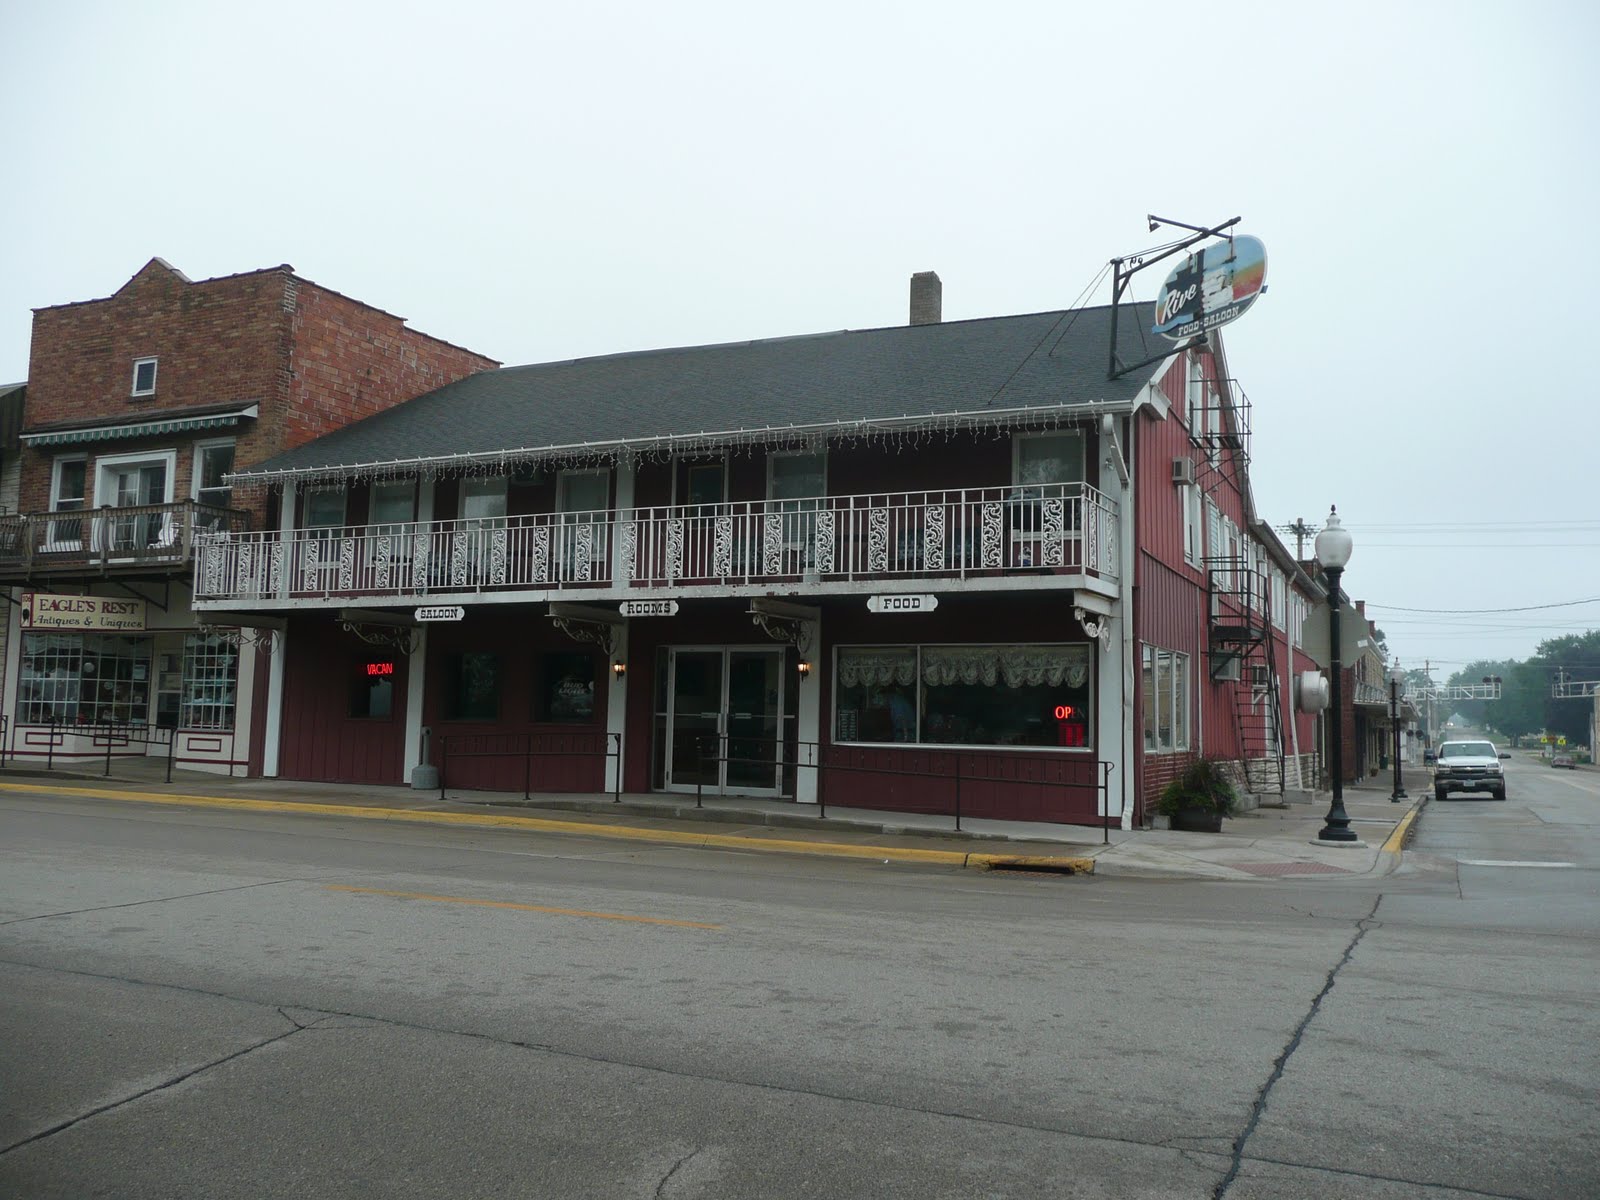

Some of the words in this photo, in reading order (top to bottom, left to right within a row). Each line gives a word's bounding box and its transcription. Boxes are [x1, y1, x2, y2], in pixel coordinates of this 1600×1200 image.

[39, 598, 96, 613] EAGLE'S
[101, 601, 139, 615] REST
[627, 602, 671, 614] ROOMS
[883, 597, 921, 609] FOOD
[420, 608, 458, 619] SALOON
[33, 614, 80, 628] Antiques
[83, 617, 93, 626] &
[100, 616, 143, 629] Uniques
